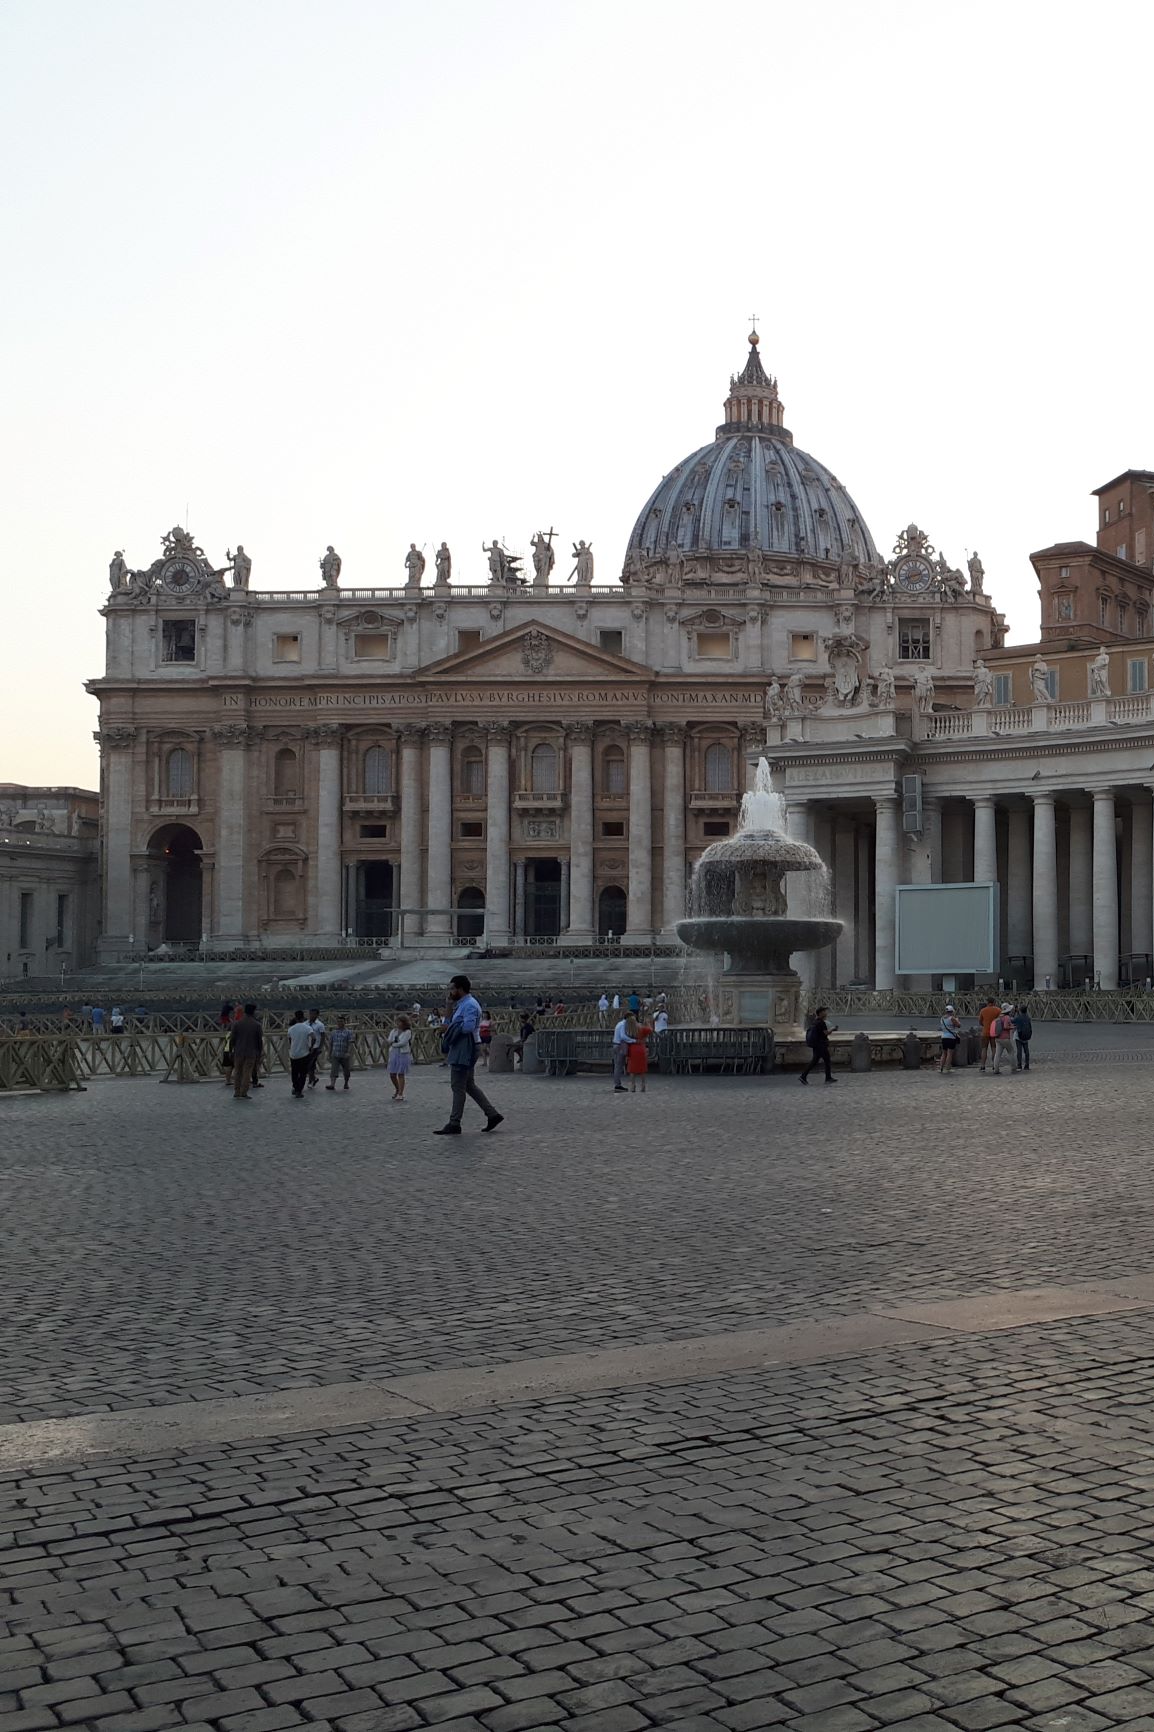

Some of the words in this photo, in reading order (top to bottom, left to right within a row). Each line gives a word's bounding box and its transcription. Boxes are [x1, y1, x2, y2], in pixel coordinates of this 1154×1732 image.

[222, 695, 240, 706] IN
[249, 696, 317, 708] HONOREM
[318, 694, 387, 706] PRINCIPIS
[430, 692, 475, 703] PAVLVS
[489, 692, 573, 703] BVRGHESIVS
[576, 691, 647, 703] ROMANVS
